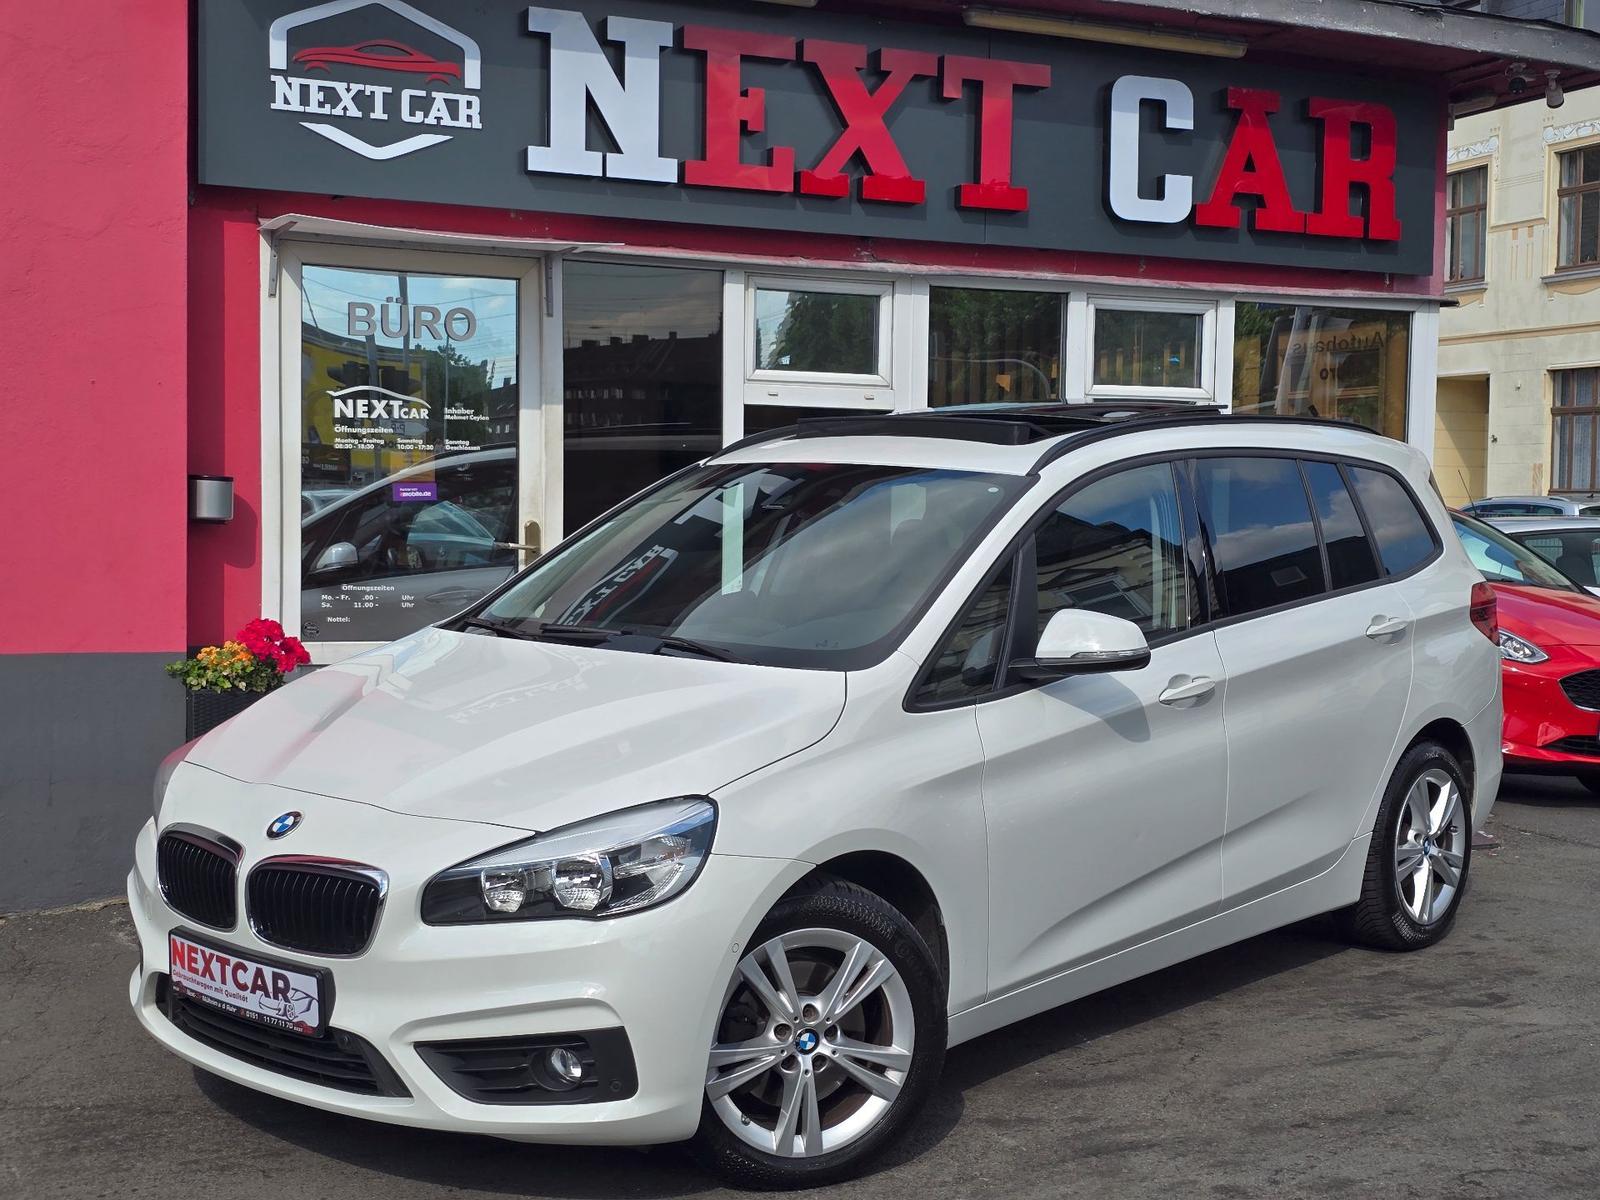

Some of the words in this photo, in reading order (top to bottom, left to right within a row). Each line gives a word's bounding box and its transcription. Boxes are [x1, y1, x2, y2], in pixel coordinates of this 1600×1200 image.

[270, 75, 393, 121] NEXT
[401, 88, 482, 129] CAR
[525, 5, 1051, 212] NEXT
[1109, 75, 1402, 241] CAR
[347, 297, 477, 342] BÜRO
[334, 424, 394, 435] Öffnungszeiten
[444, 407, 475, 415] Inhaber
[342, 583, 395, 592] Öffnungszeiten
[171, 937, 292, 1004] NEXTCAR
